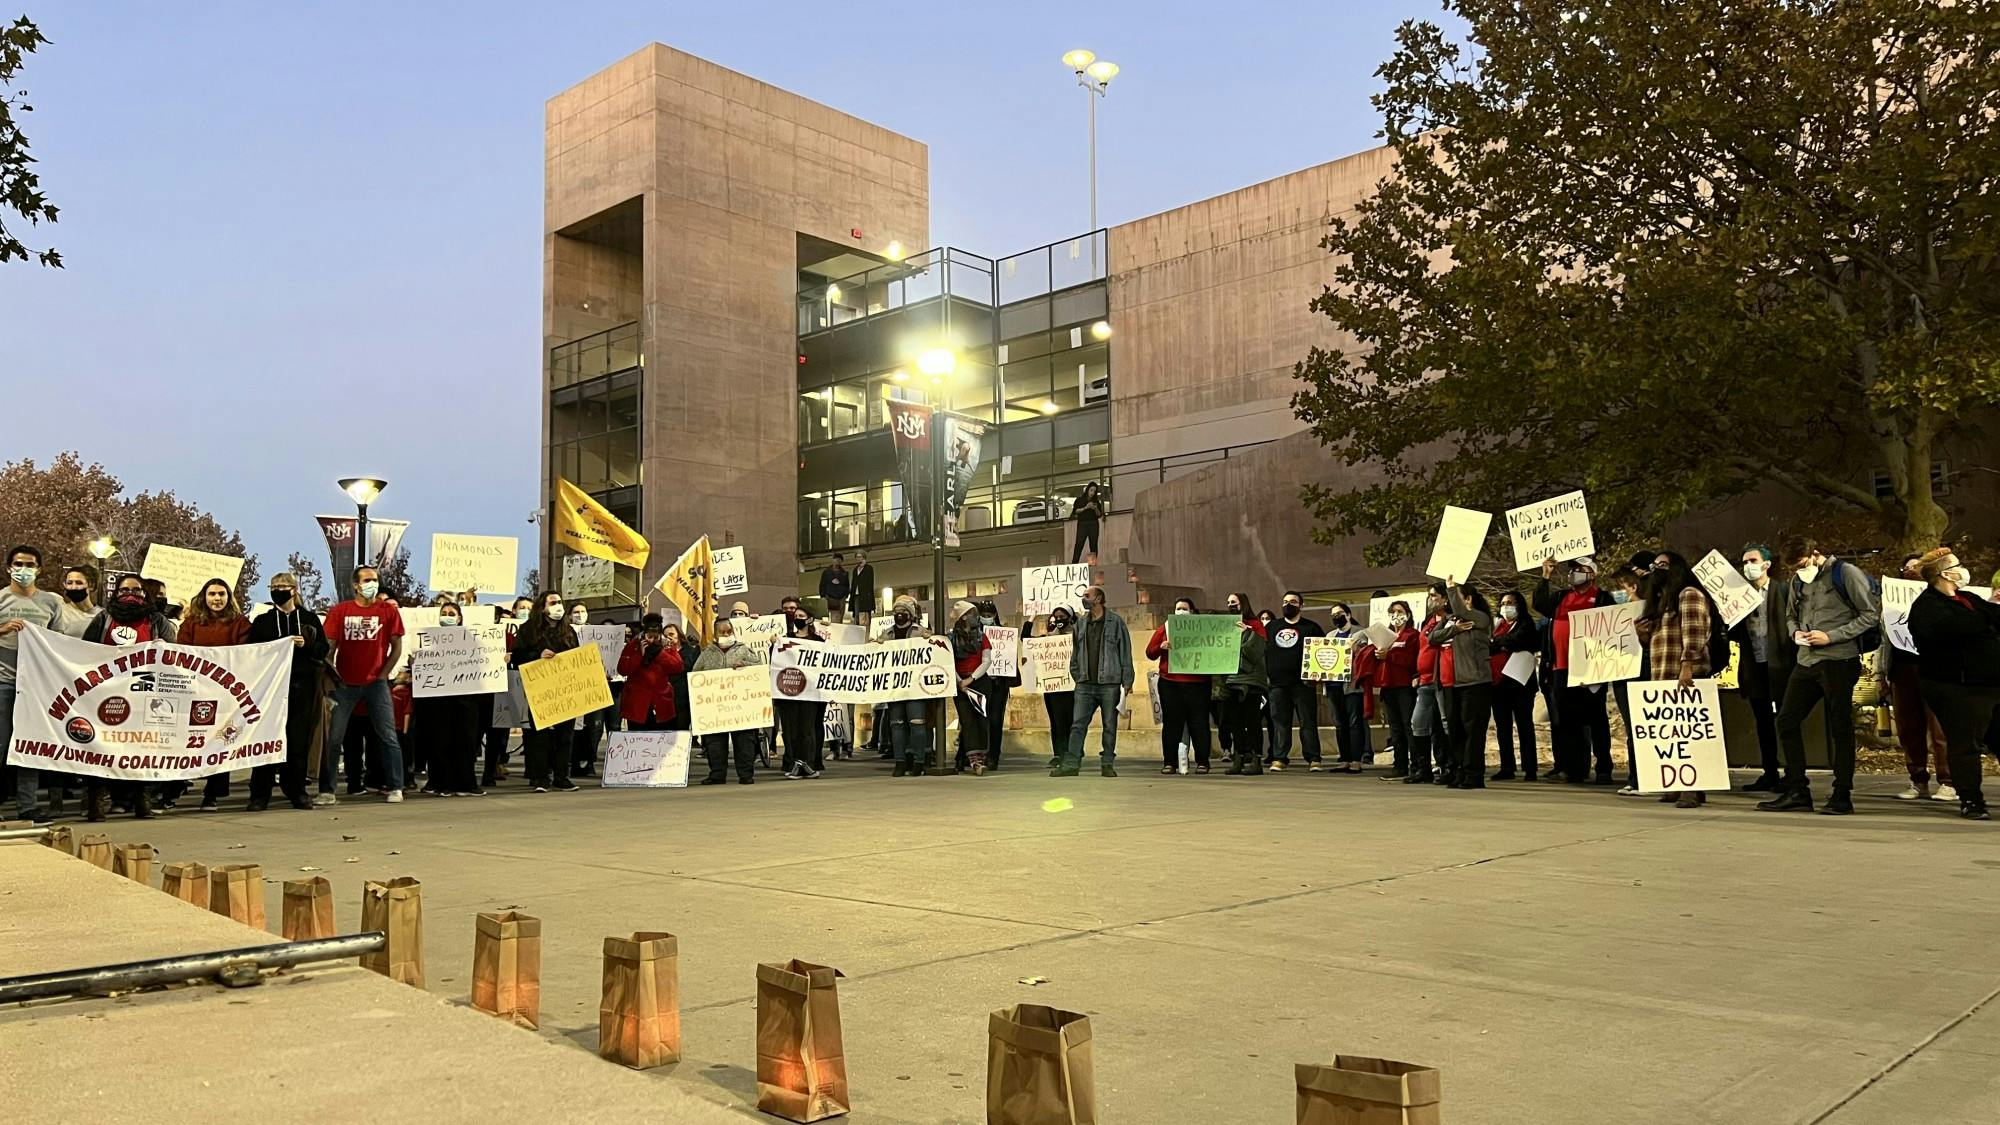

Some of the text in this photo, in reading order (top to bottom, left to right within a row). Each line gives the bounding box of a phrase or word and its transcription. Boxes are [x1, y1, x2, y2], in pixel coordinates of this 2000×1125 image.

[1510, 512, 1532, 528] NOS
[1542, 533, 1551, 543] E
[1695, 556, 1725, 581] DER
[1028, 584, 1088, 601] JUSTO
[1721, 600, 1744, 619] VER
[1175, 620, 1203, 632] UNM
[1573, 608, 1632, 640] LIVING
[344, 629, 365, 640] YES
[417, 633, 454, 648] TENGO
[1173, 634, 1232, 650] BECAUSE
[1584, 634, 1631, 660] WAGE
[569, 648, 598, 669] WAGE
[797, 647, 933, 671] THE UNIVERSITY WORKS
[1592, 656, 1634, 680] NOW
[48, 687, 76, 721] WE
[74, 664, 113, 696] ARE
[114, 649, 157, 672] THE
[691, 672, 760, 688] Queremos
[816, 671, 912, 692] BECAUSE WE DO!
[696, 690, 738, 705] Salario
[1643, 689, 1702, 705] UNM
[1643, 707, 1709, 722] WORKS
[102, 731, 158, 743] LiUNA!
[1635, 723, 1716, 740] BECAUSE
[186, 736, 205, 749] 23
[1654, 741, 1691, 759] WE
[15, 739, 114, 768] UNM/UNMH
[118, 755, 202, 769] COALITION
[206, 751, 229, 766] OF
[1661, 764, 1697, 788] DO
